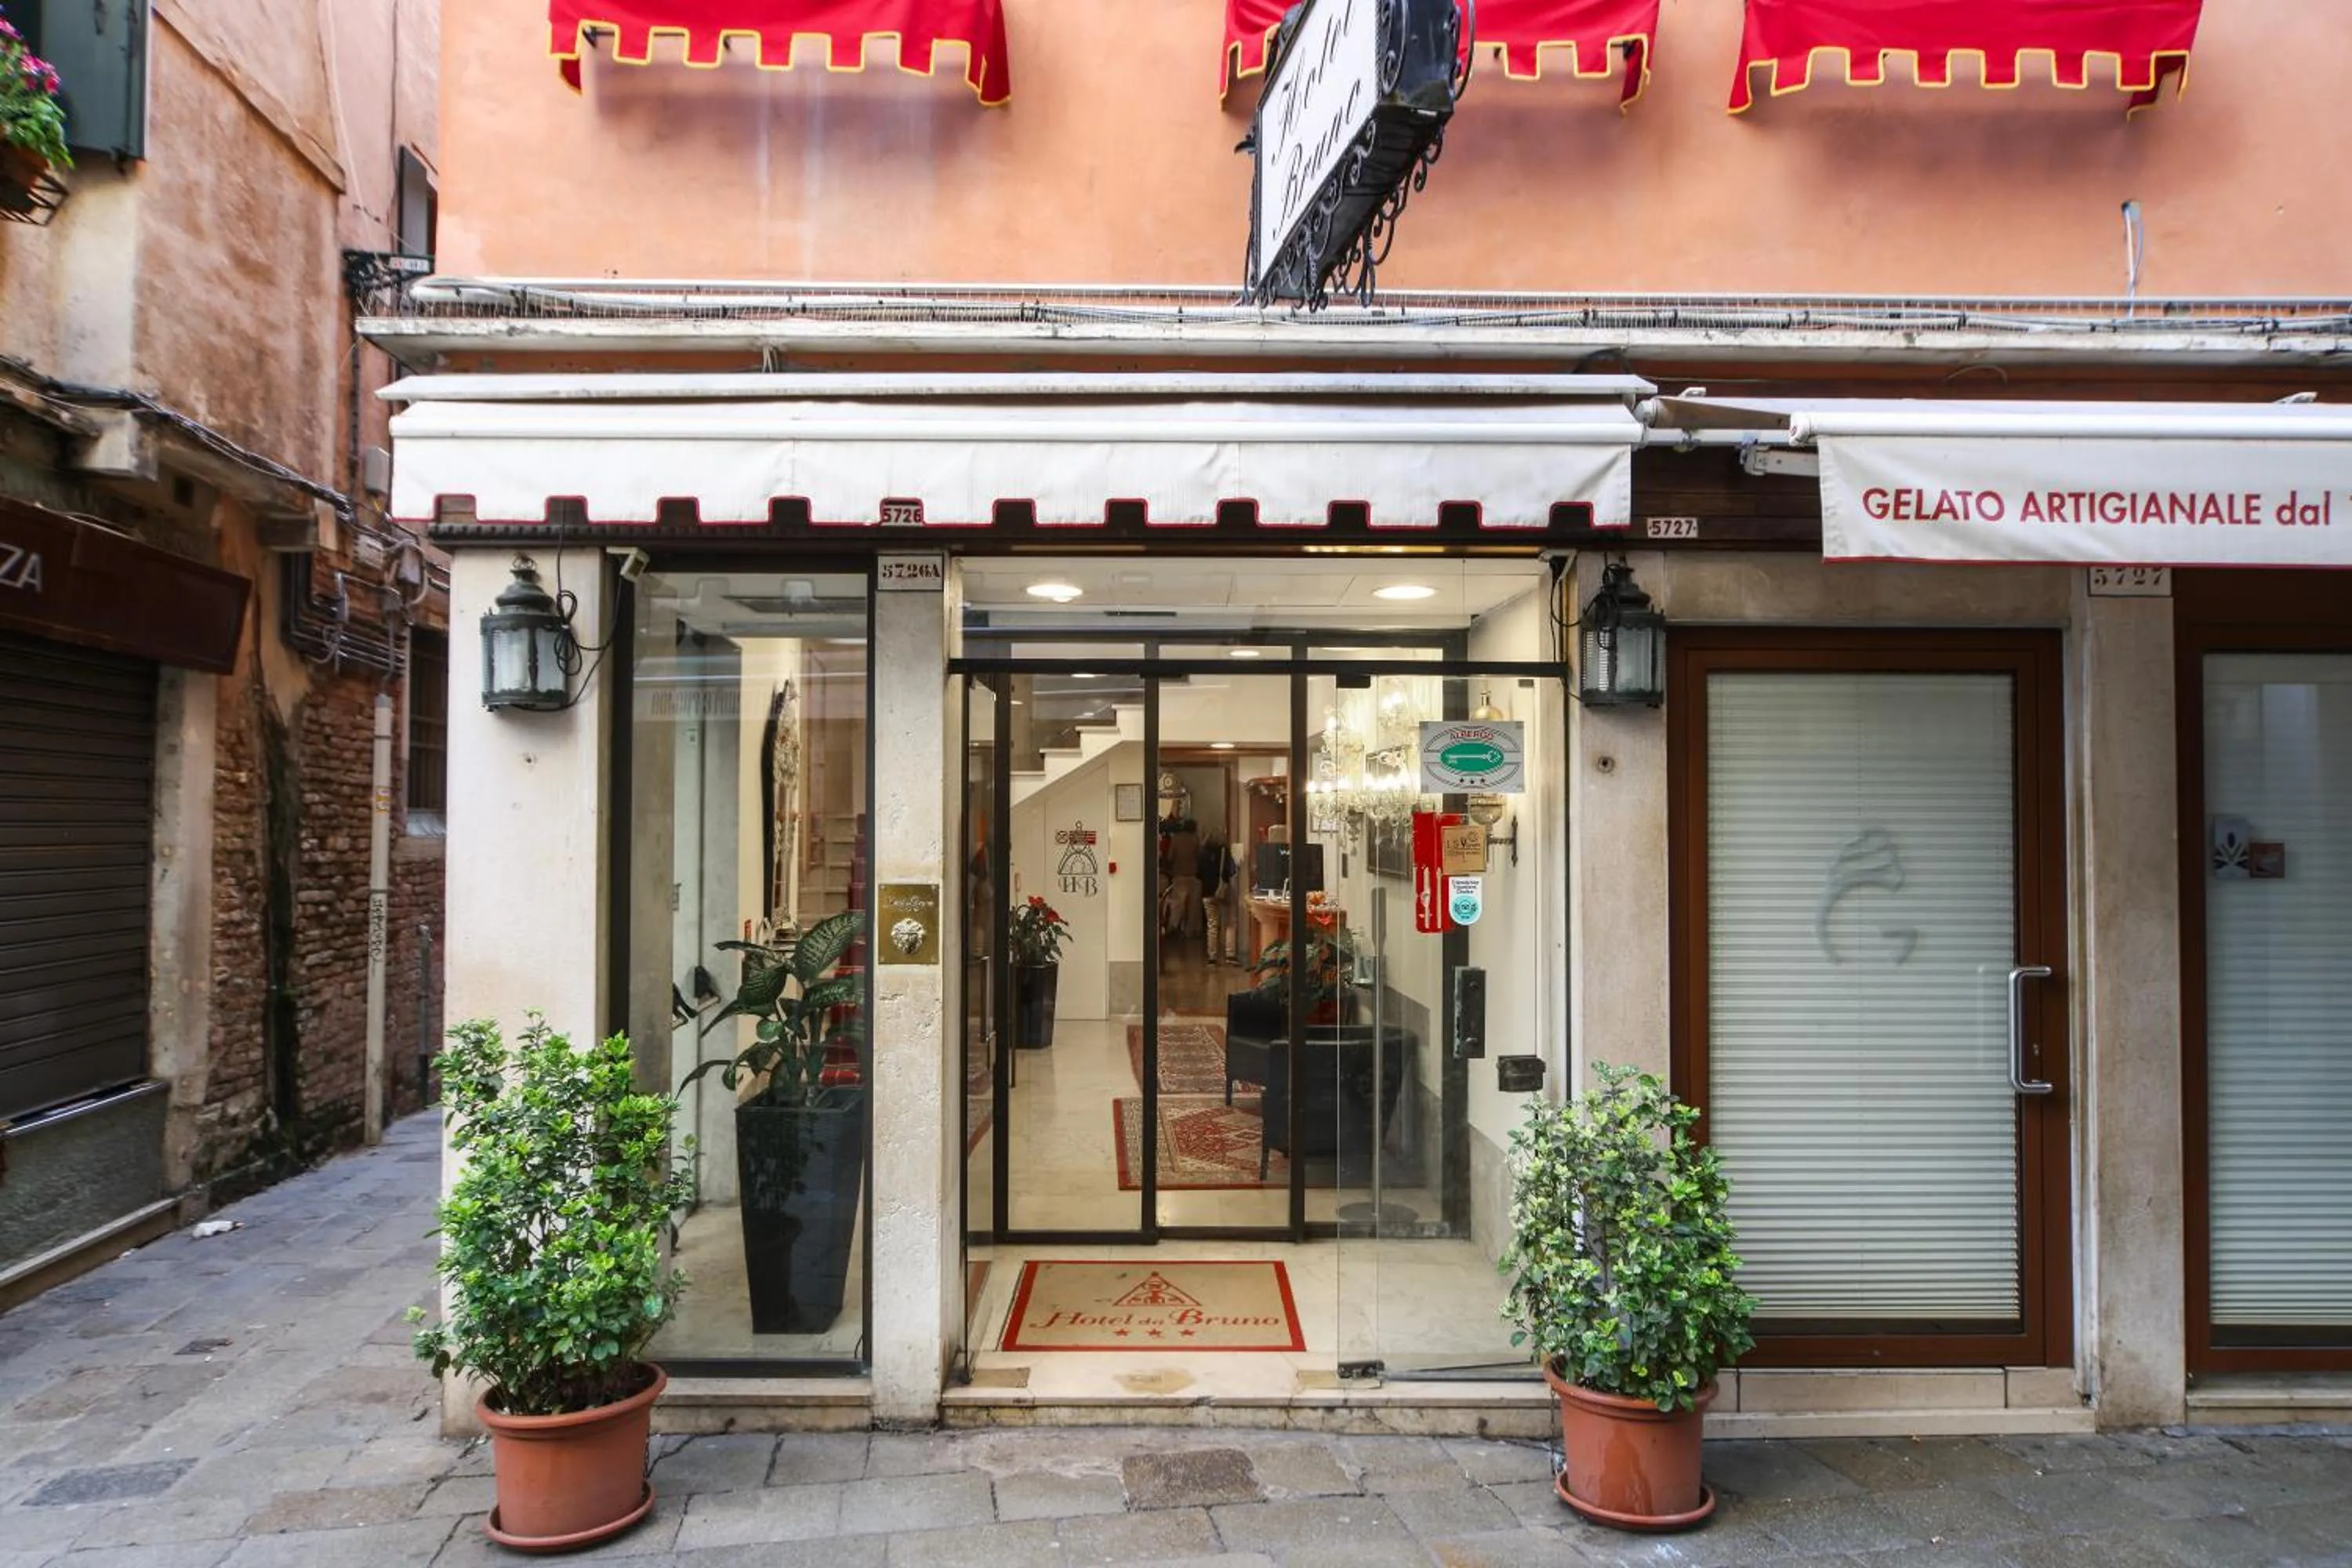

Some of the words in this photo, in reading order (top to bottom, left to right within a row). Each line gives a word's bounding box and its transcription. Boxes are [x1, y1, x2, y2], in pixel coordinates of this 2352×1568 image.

[1862, 487, 2005, 522] GELATO
[2020, 490, 2262, 525] ARTIGIANALE
[2275, 489, 2331, 525] dal
[883, 507, 922, 524] 5726
[1650, 519, 1693, 535] 5727
[882, 563, 942, 579] 5726A
[2094, 566, 2163, 586] 5727
[1028, 1311, 1133, 1329] Hotel
[1168, 1308, 1280, 1326] Bruno
